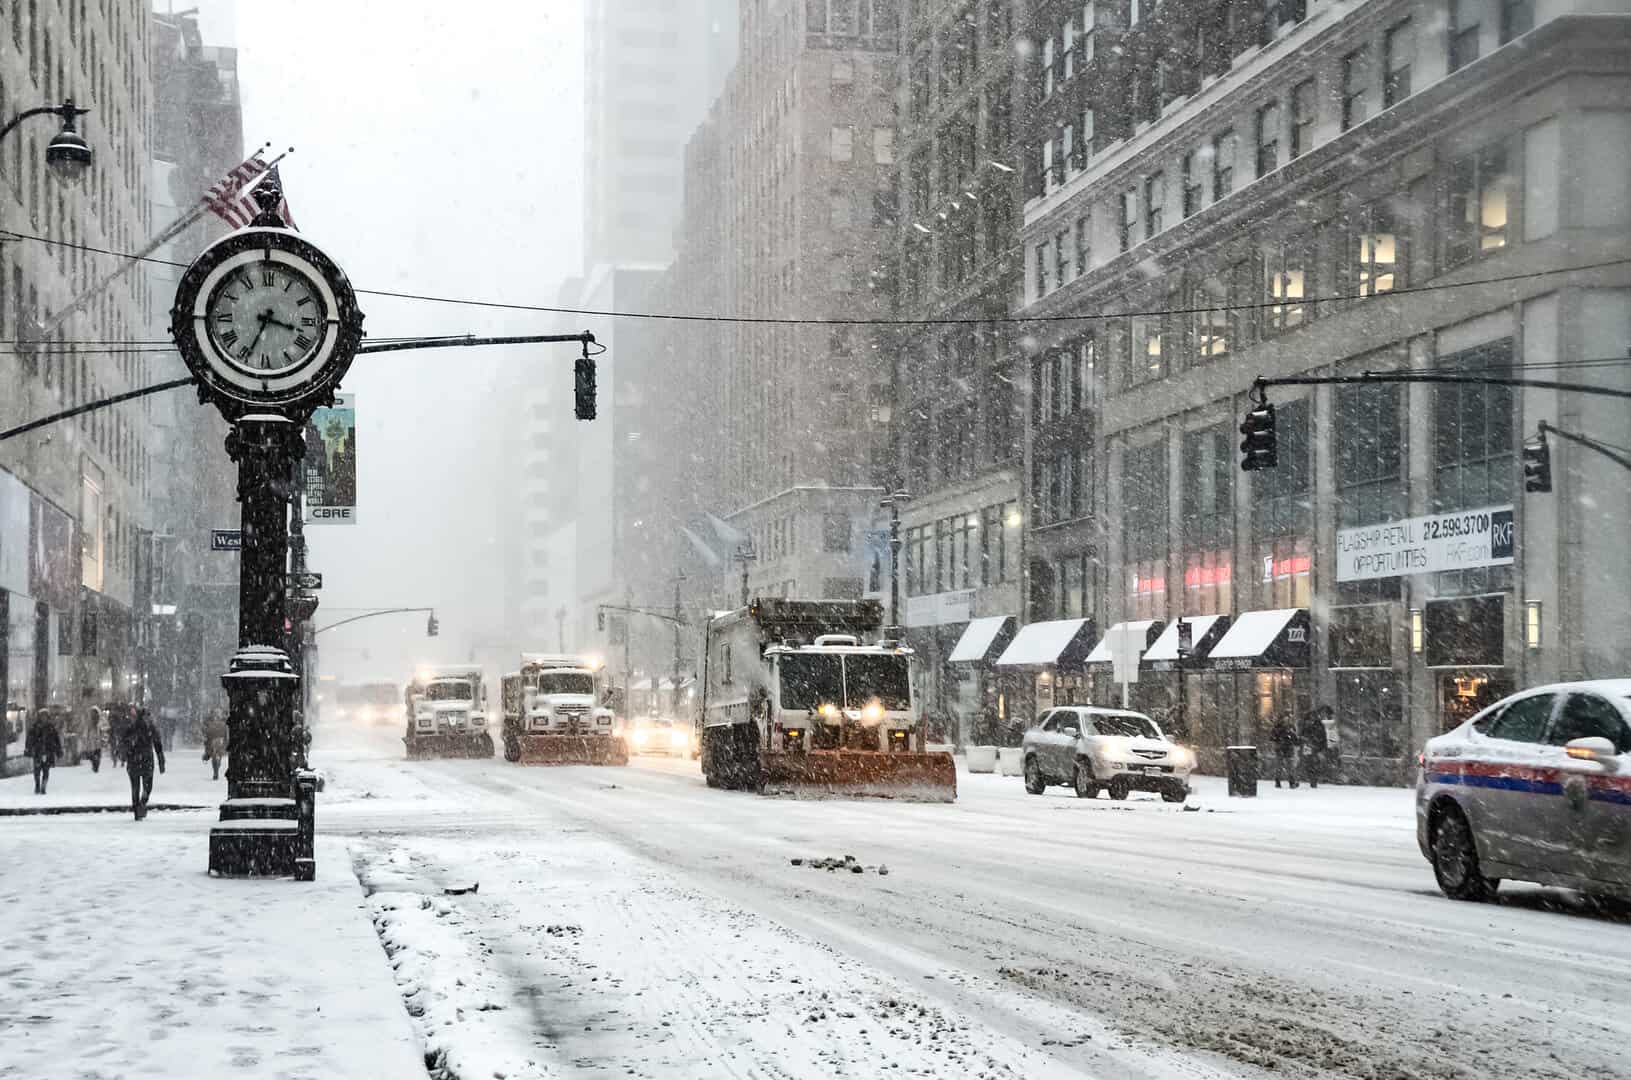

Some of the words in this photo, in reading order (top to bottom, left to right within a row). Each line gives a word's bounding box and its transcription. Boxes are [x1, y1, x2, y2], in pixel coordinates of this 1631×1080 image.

[312, 508, 351, 518] CBRE
[1337, 528, 1381, 552] FLAGSHIP
[1384, 524, 1415, 547] RETAIL
[1493, 521, 1514, 548] RKF
[1353, 547, 1427, 573] OPPORTUNITIES
